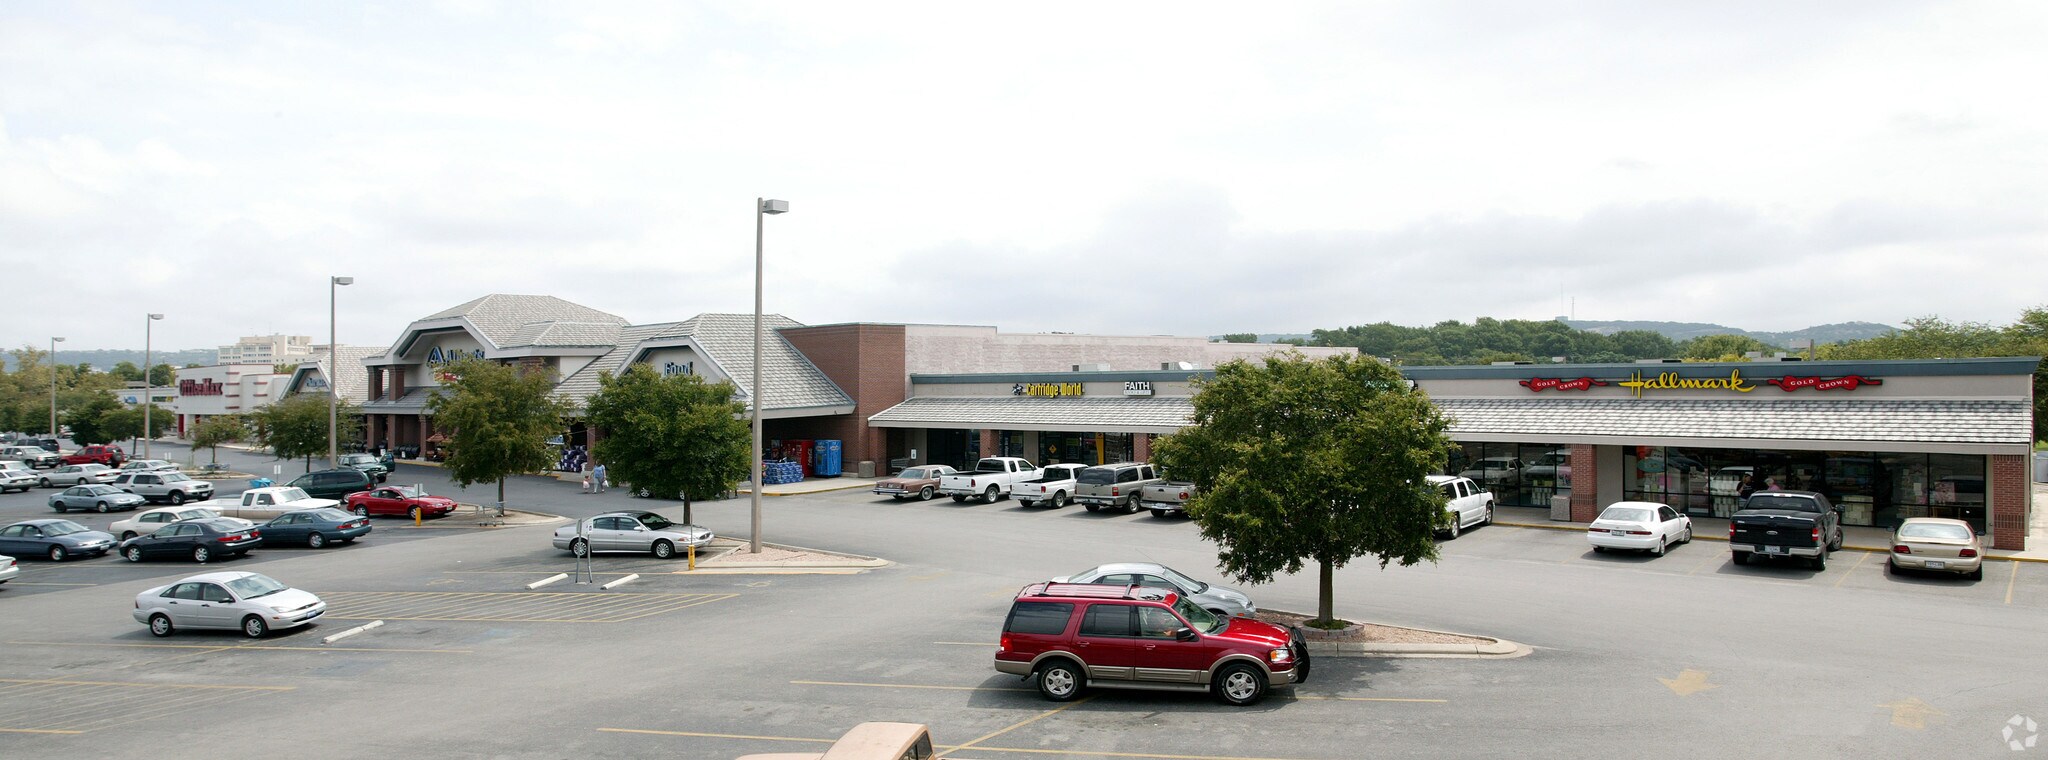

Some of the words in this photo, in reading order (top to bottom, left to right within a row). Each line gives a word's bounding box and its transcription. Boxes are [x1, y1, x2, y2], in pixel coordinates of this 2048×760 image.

[1124, 381, 1150, 390] FAITH
[1559, 381, 1584, 390] CROWN
[1618, 369, 1756, 399] Hallmark
[1819, 379, 1849, 389] CROWN
[1026, 382, 1059, 398] Cartridge
[1060, 382, 1082, 396] World
